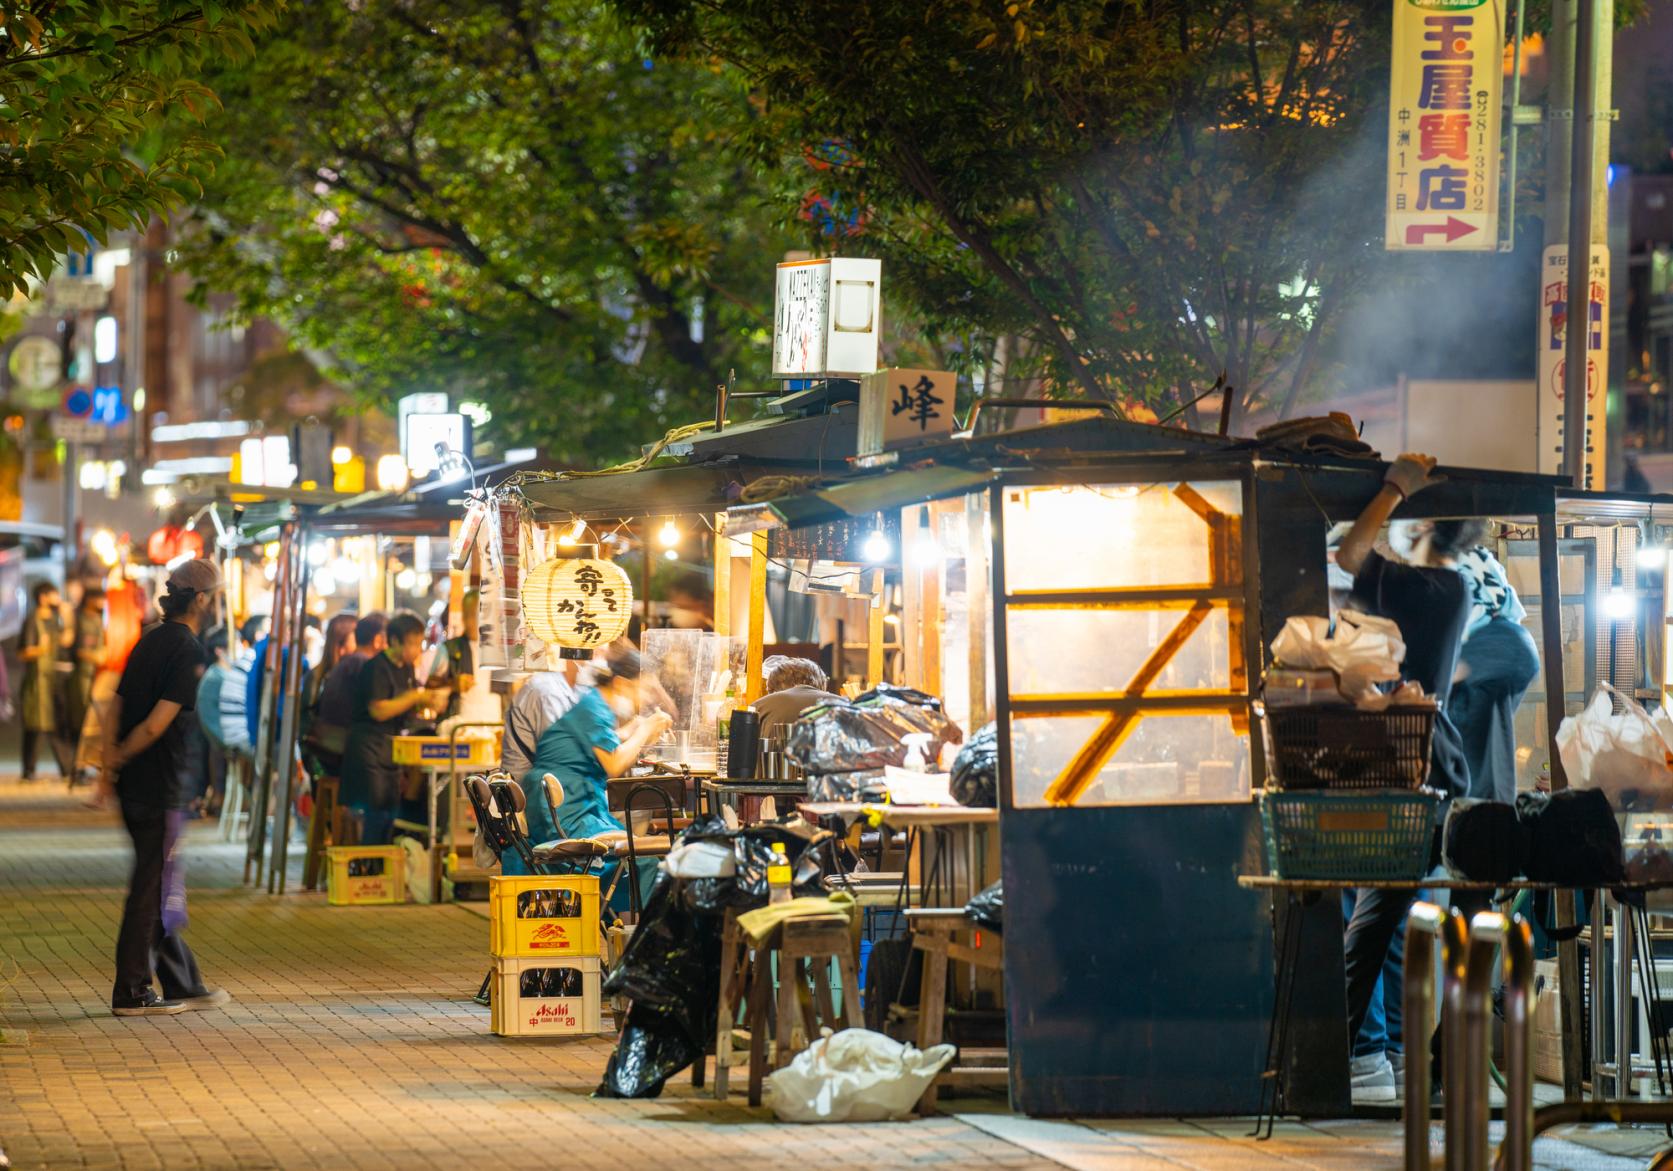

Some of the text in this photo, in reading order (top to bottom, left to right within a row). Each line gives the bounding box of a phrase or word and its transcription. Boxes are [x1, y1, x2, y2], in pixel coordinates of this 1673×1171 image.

[1416, 16, 1474, 211] 玉屋質店
[892, 375, 944, 431] 峰
[529, 1017, 538, 1028] 中
[565, 1017, 576, 1026] 20
[536, 1003, 568, 1016] Asahi
